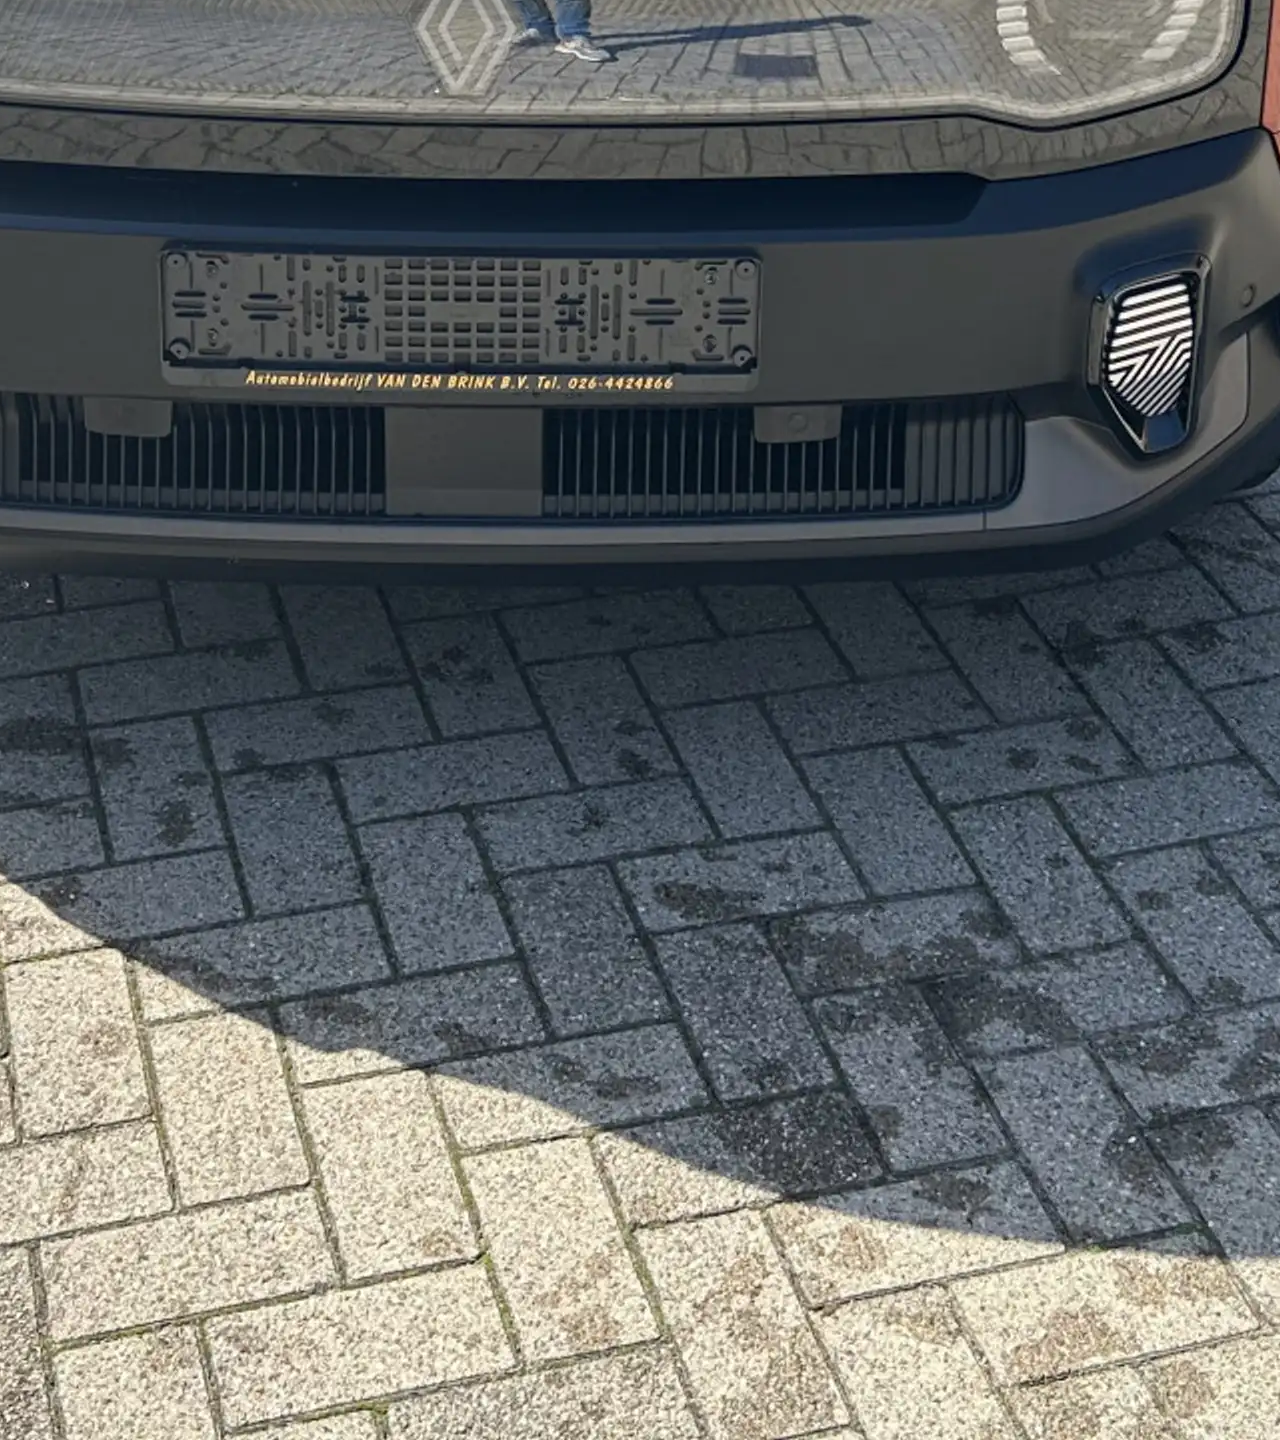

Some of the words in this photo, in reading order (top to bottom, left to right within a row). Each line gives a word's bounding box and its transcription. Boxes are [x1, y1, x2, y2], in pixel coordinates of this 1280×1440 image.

[376, 373, 406, 388] VAN
[411, 375, 442, 389] DEN
[447, 376, 495, 390] BRINK
[500, 376, 529, 390] B.V.
[537, 375, 561, 390] Tel.
[568, 375, 673, 390] 026-4424866
